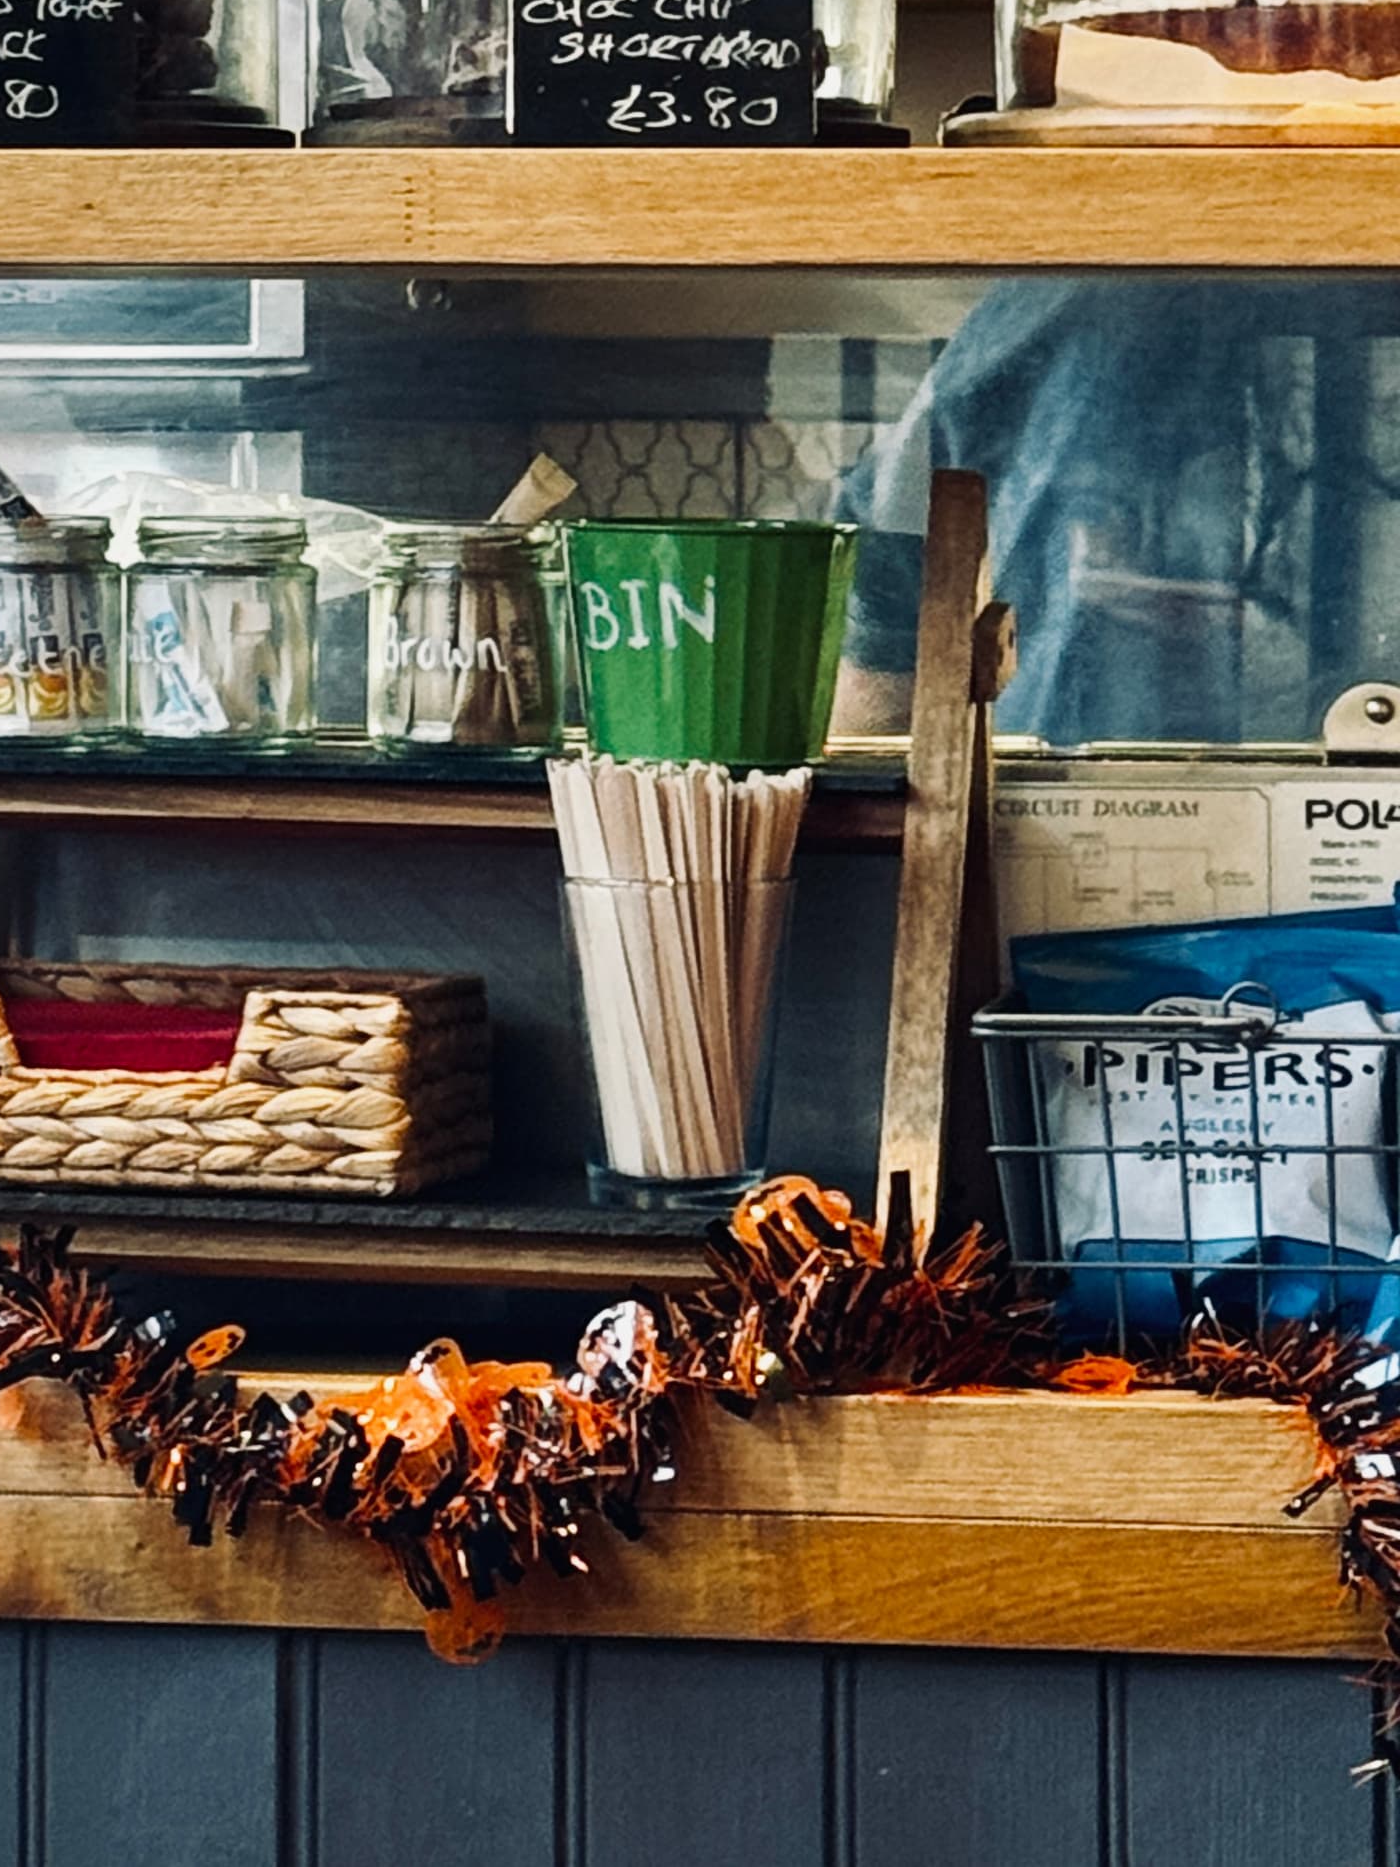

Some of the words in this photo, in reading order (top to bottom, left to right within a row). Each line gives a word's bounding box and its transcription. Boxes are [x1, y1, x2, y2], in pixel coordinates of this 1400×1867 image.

[607, 85, 778, 133] £3.80
[580, 574, 715, 650] BIN
[384, 615, 508, 671] Brown
[994, 799, 1081, 819] CIRCUIT
[1093, 799, 1199, 818] DIAGRAM
[1084, 1045, 1353, 1091] PIPERS
